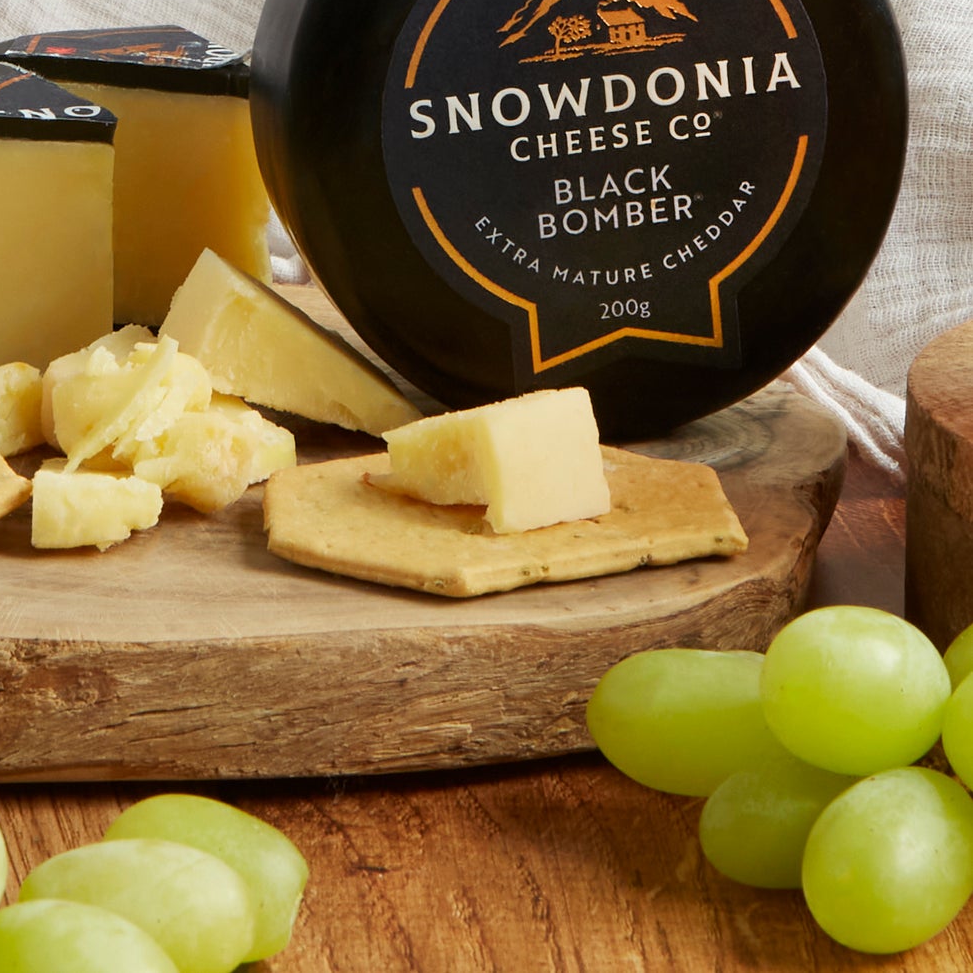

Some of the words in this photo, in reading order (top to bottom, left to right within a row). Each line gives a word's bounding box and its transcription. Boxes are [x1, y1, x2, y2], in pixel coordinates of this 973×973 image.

[409, 52, 801, 140] SNOWDONIA
[510, 120, 653, 162] CHEESE
[554, 165, 672, 205] BLACK
[475, 216, 540, 273] EXTRA
[552, 263, 653, 286] MATURE
[662, 180, 755, 270] CHEDDAR
[538, 194, 693, 239] BOMBER
[600, 298, 651, 320] 200g
